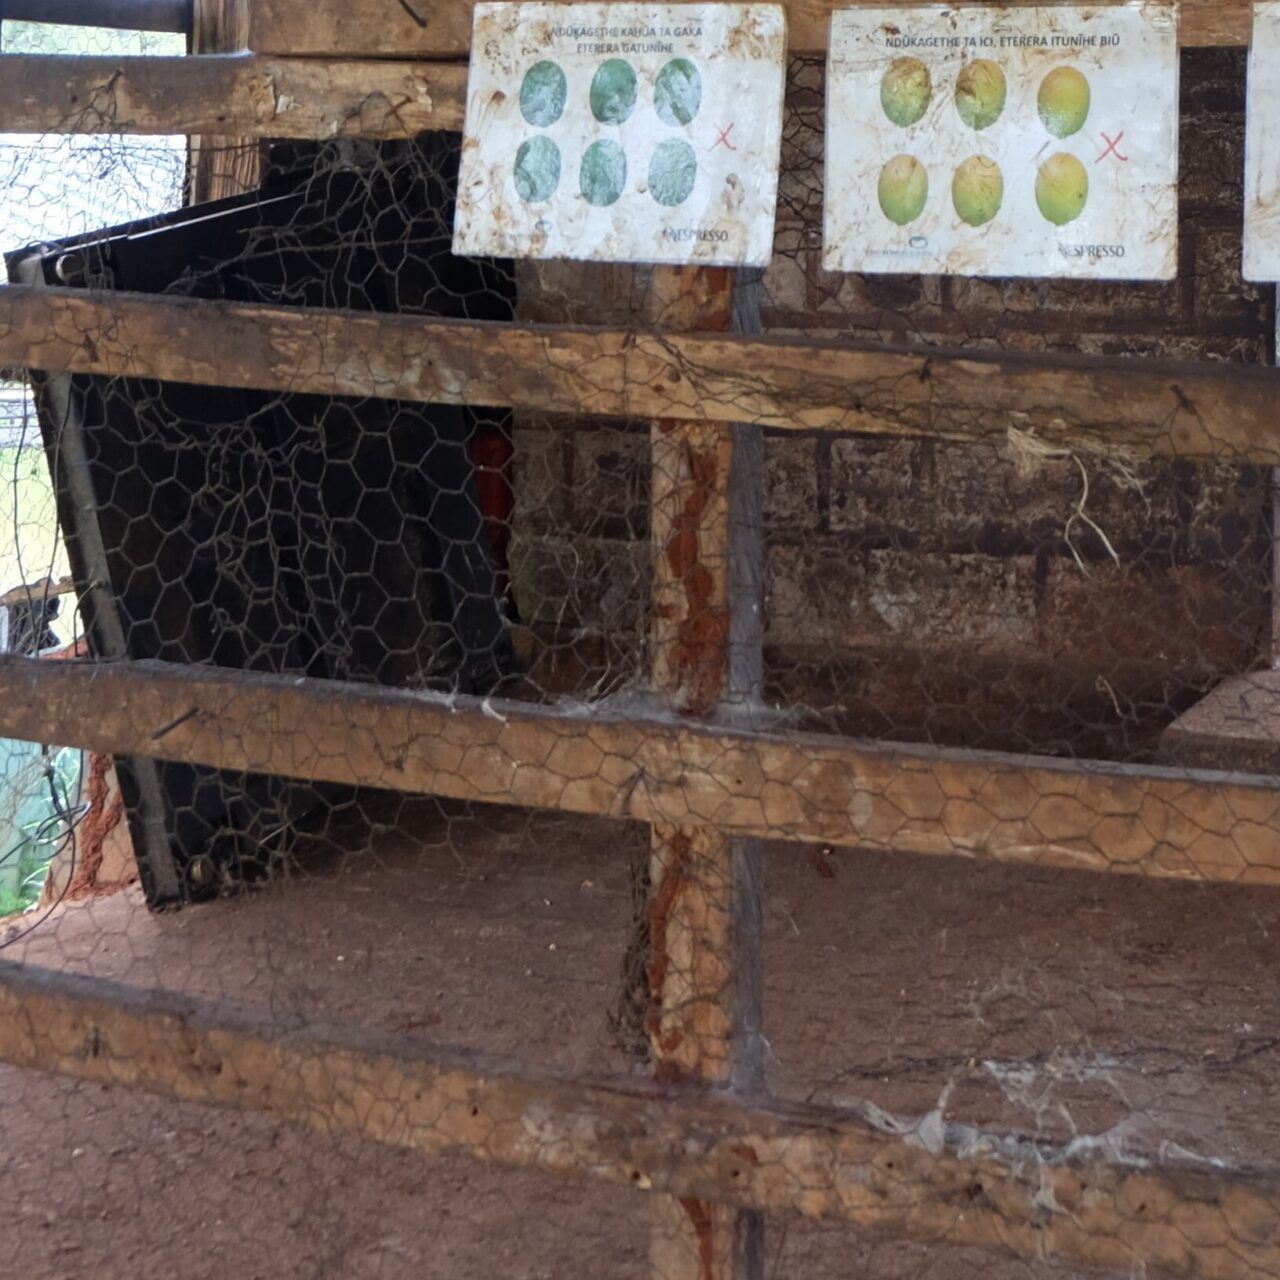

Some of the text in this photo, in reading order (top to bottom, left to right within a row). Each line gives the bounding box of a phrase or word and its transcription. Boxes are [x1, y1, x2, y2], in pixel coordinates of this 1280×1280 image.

[659, 27, 671, 36] TA
[673, 27, 703, 37] GAKA
[963, 37, 976, 47] TA
[1000, 36, 1047, 47] ETERERA
